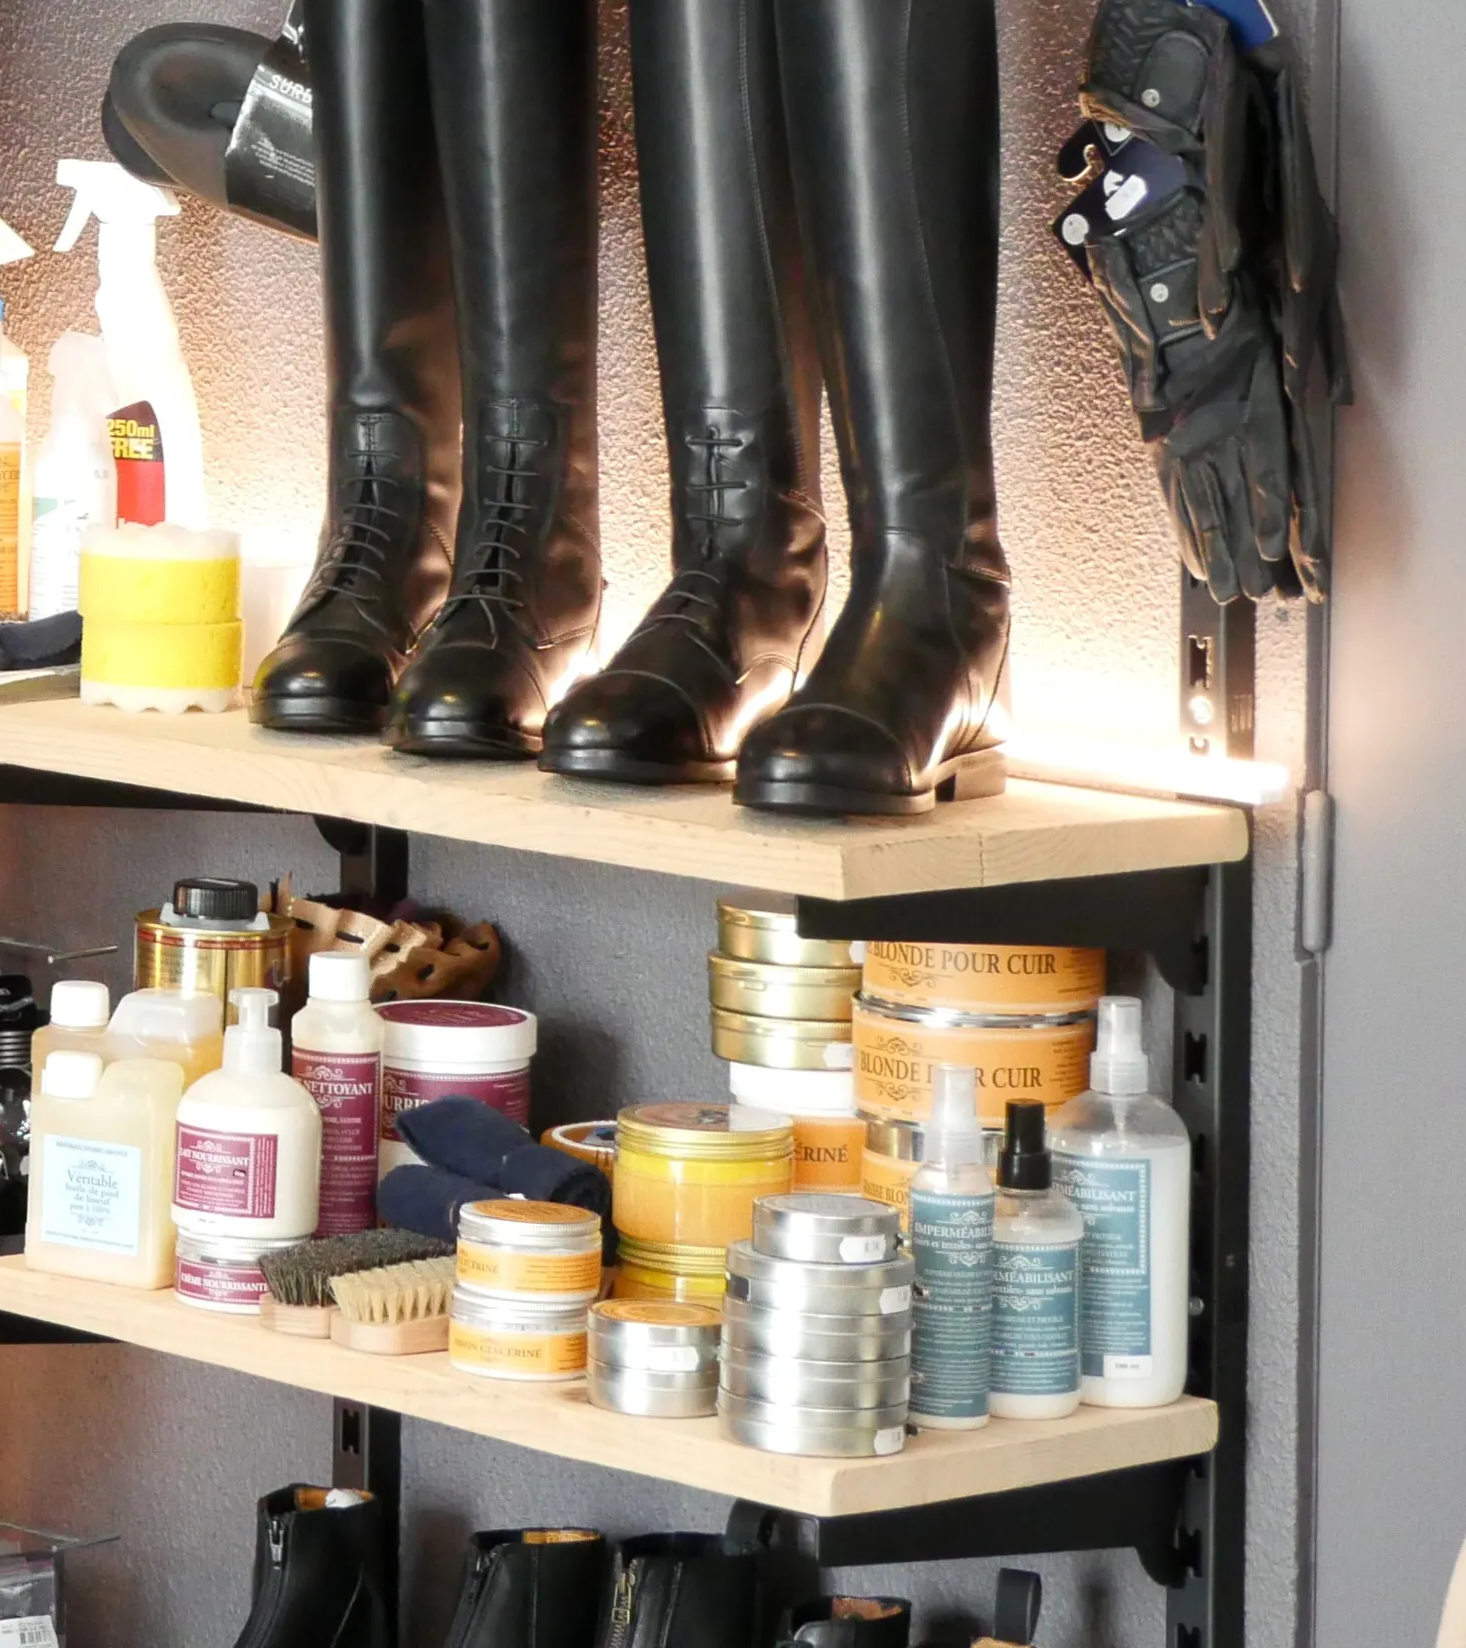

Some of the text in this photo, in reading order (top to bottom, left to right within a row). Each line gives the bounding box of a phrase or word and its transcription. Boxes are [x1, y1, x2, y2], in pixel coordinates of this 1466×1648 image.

[874, 942, 1057, 975] BLONDE POUR CUIR
[861, 1051, 922, 1084] BLONDE
[992, 1067, 1043, 1088] CUIR
[794, 1136, 849, 1164] ÉRINÉ
